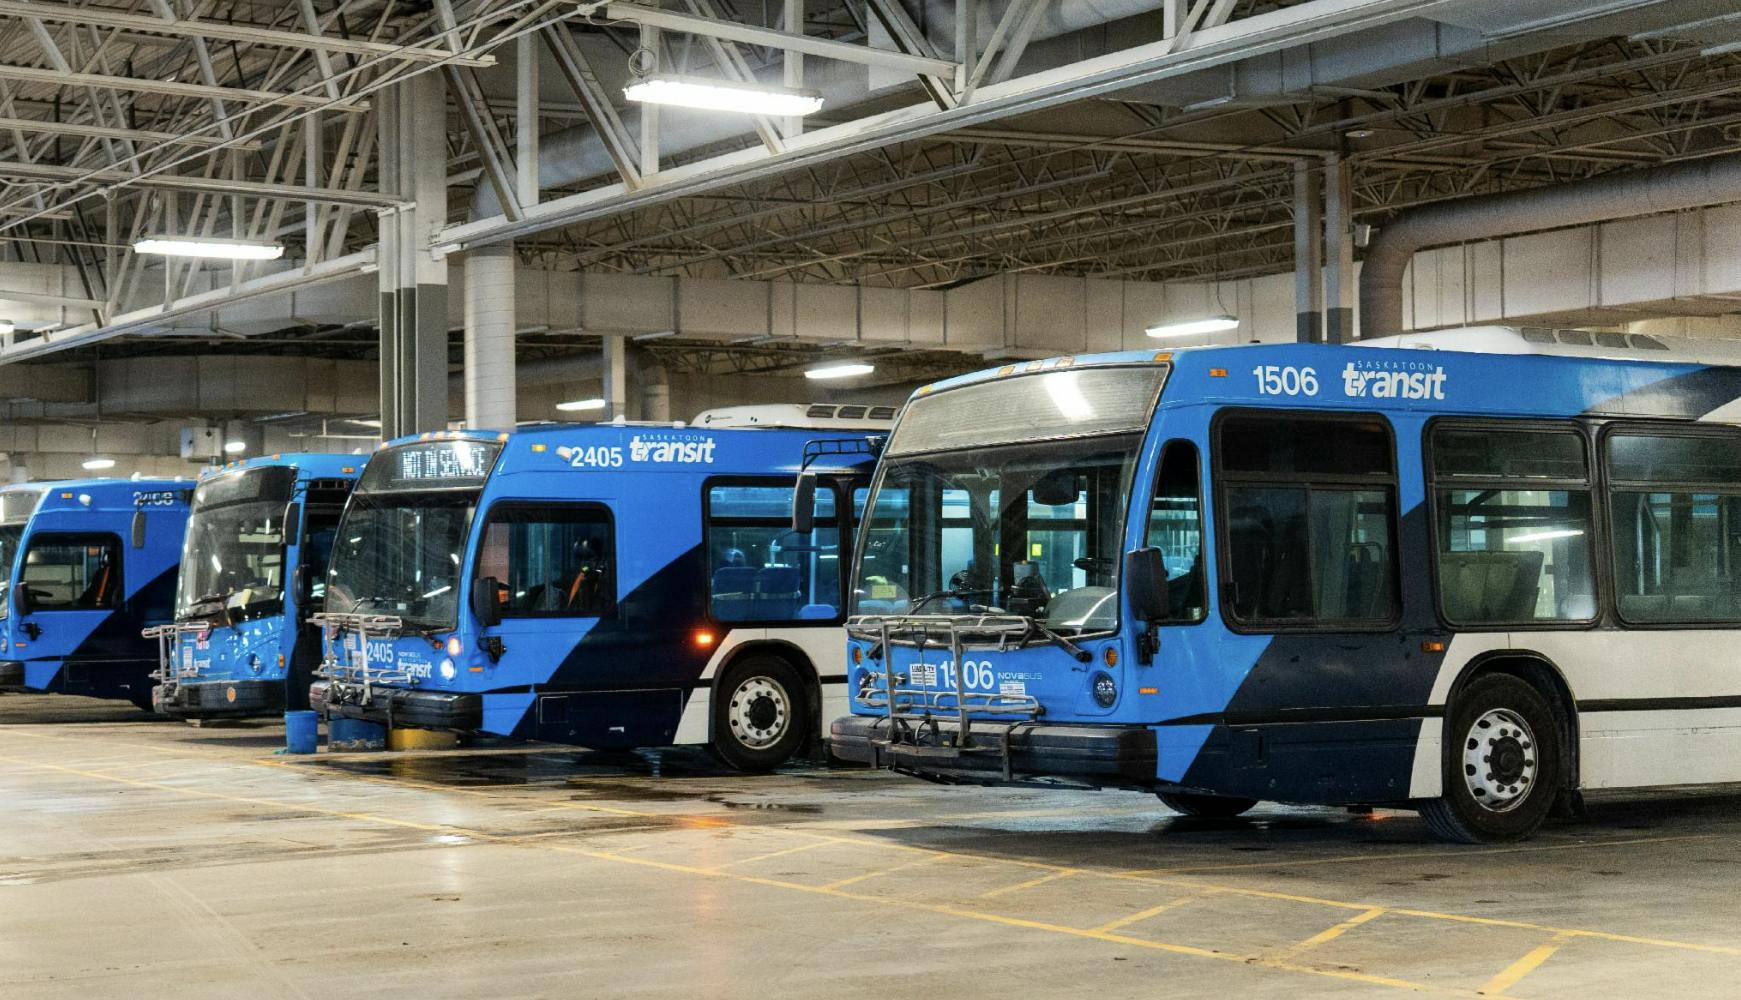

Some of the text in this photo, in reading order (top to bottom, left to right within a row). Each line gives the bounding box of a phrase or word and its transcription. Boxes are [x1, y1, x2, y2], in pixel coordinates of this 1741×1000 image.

[1357, 360, 1434, 370] SASKATOON
[1253, 365, 1319, 396] 1506
[1342, 362, 1447, 400] transit
[629, 435, 716, 463] transit
[642, 433, 705, 441] SASKATOON
[440, 447, 485, 477] SERCE
[571, 446, 623, 467] 2405
[366, 642, 393, 663] 2405
[397, 658, 432, 678] transit
[940, 660, 995, 690] 1506
